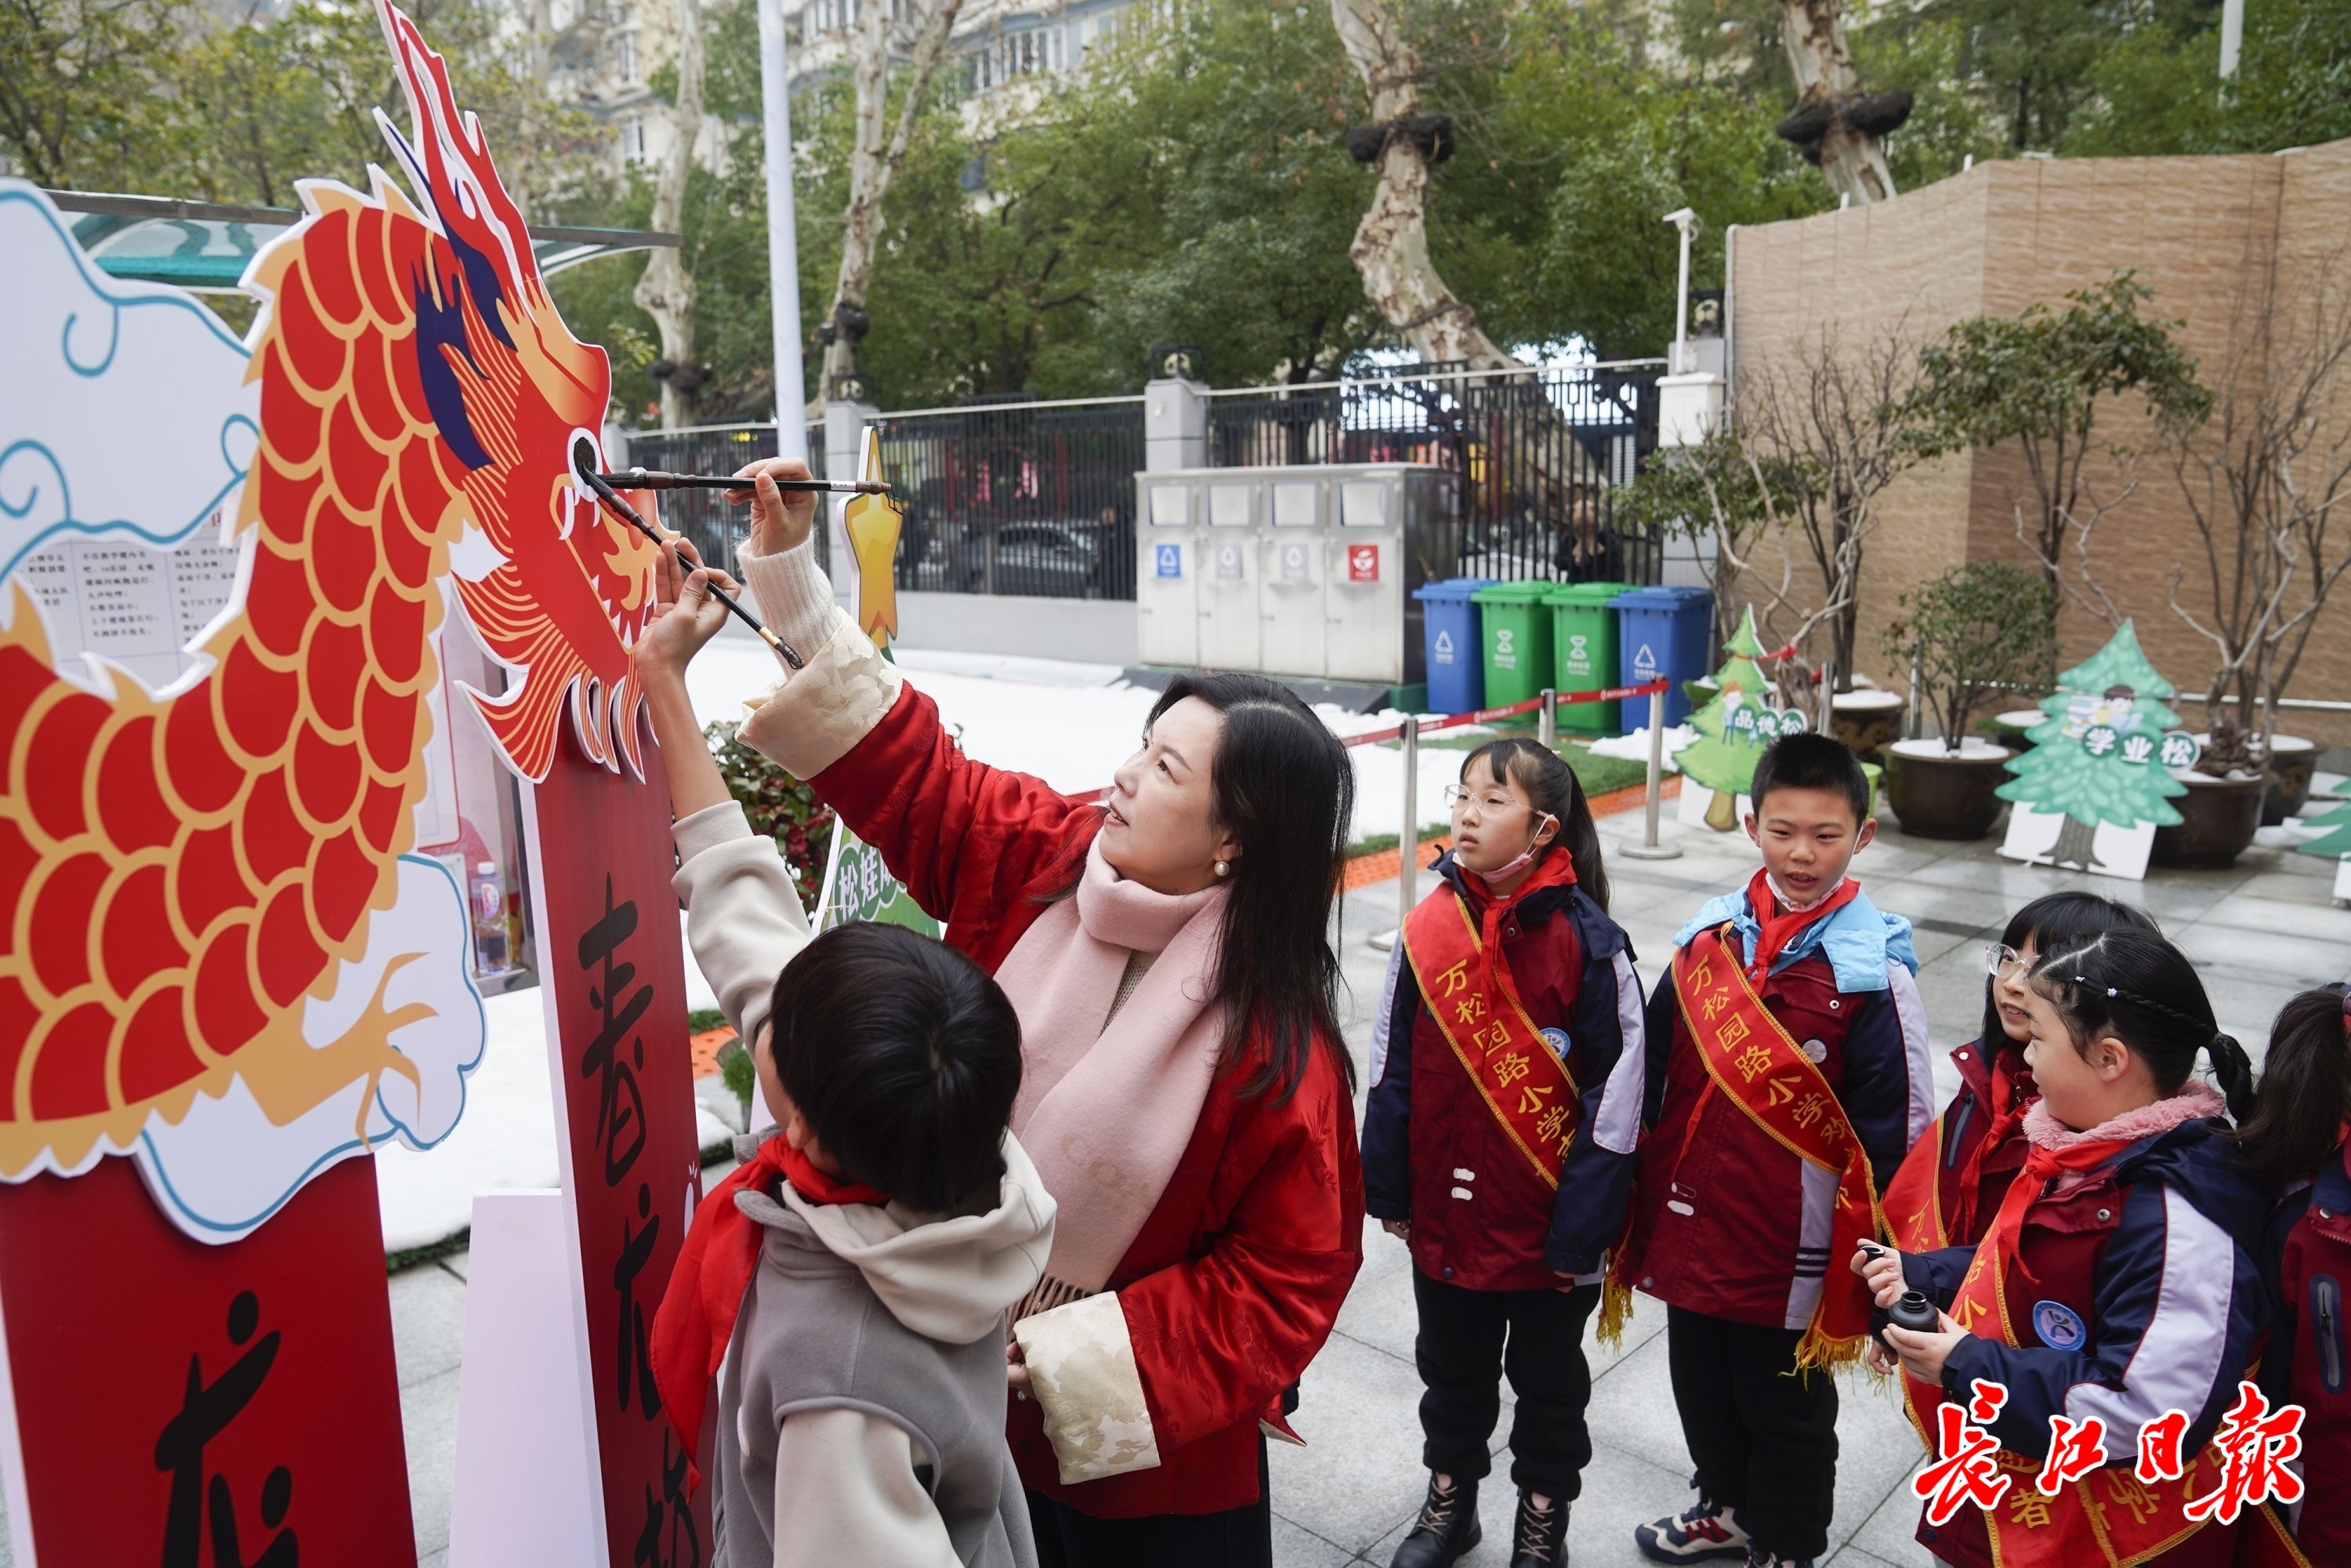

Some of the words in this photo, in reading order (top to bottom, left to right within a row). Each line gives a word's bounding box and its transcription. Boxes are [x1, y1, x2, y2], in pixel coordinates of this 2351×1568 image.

[1734, 709, 1804, 737] 品德松
[2084, 727, 2195, 766] 学业松
